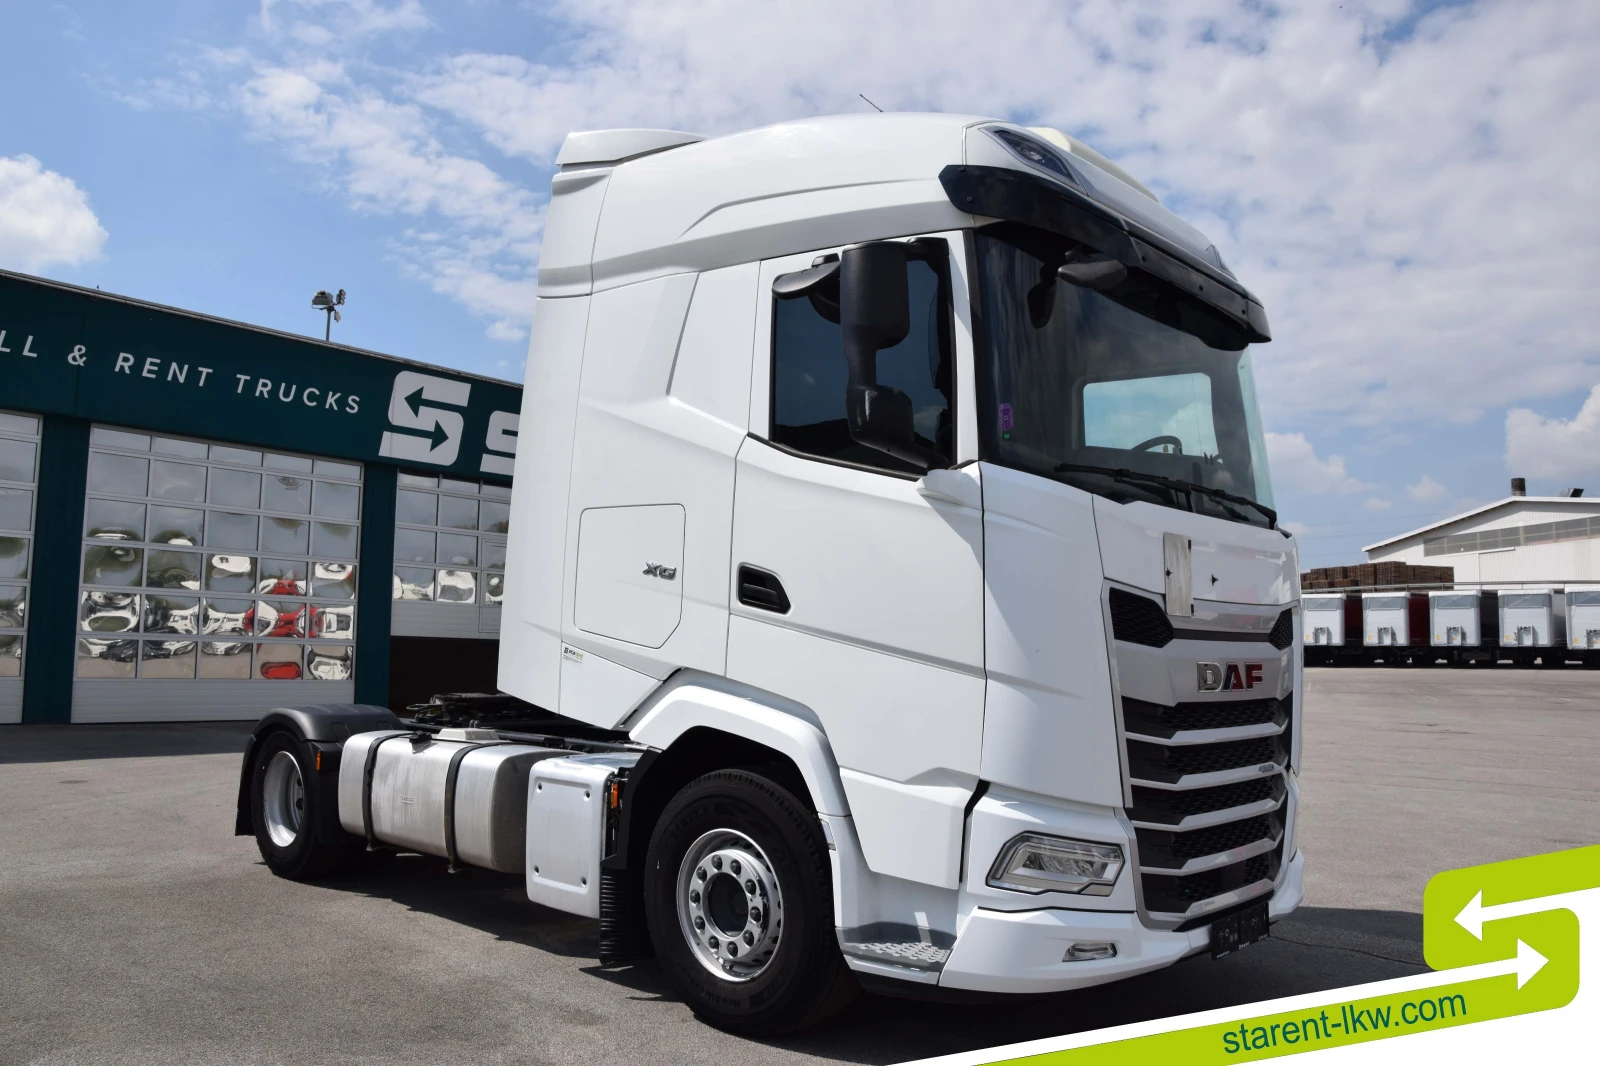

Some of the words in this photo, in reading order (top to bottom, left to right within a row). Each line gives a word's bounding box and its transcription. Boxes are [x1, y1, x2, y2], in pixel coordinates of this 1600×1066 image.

[67, 344, 87, 367] &
[114, 352, 213, 387] RENT
[236, 374, 360, 414] TRUCKS
[642, 561, 677, 581] XG
[1197, 661, 1264, 693] DAF
